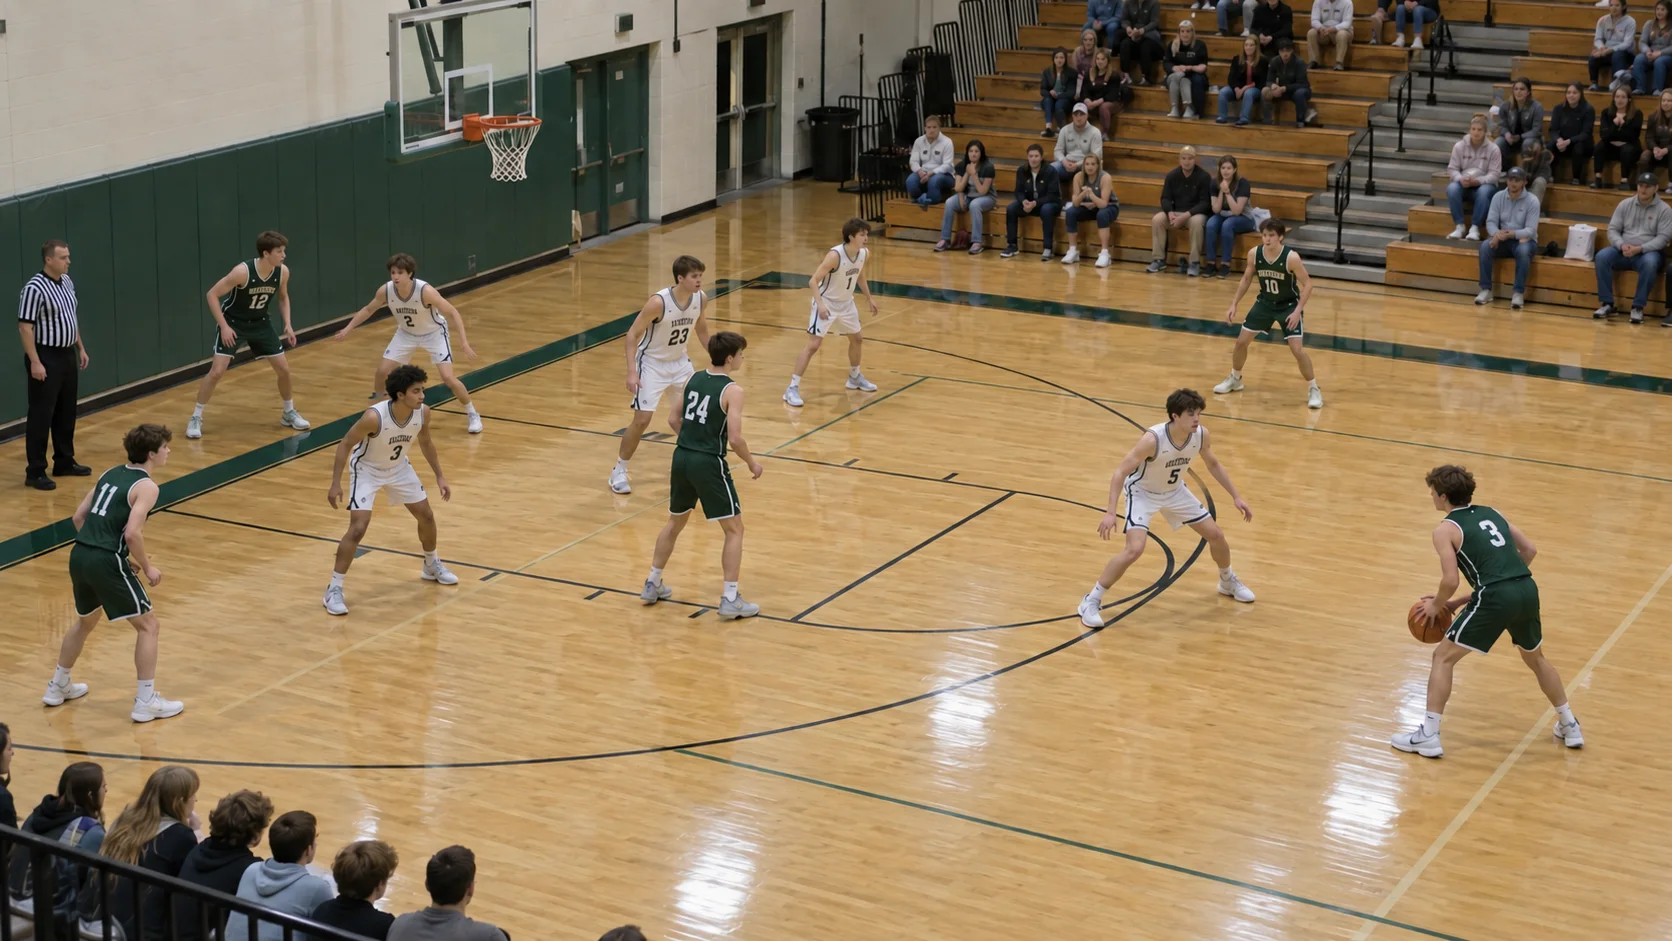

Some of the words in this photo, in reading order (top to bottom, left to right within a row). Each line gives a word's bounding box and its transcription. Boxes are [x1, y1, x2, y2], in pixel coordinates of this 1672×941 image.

[846, 277, 852, 290] 1
[1265, 280, 1279, 295] 10
[249, 295, 269, 310] 12
[404, 316, 415, 327] 2
[668, 328, 689, 346] 23
[684, 390, 710, 424] 24
[390, 445, 403, 461] 3
[1168, 468, 1181, 485] 5
[91, 482, 118, 517] 11
[1479, 520, 1506, 548] 3
